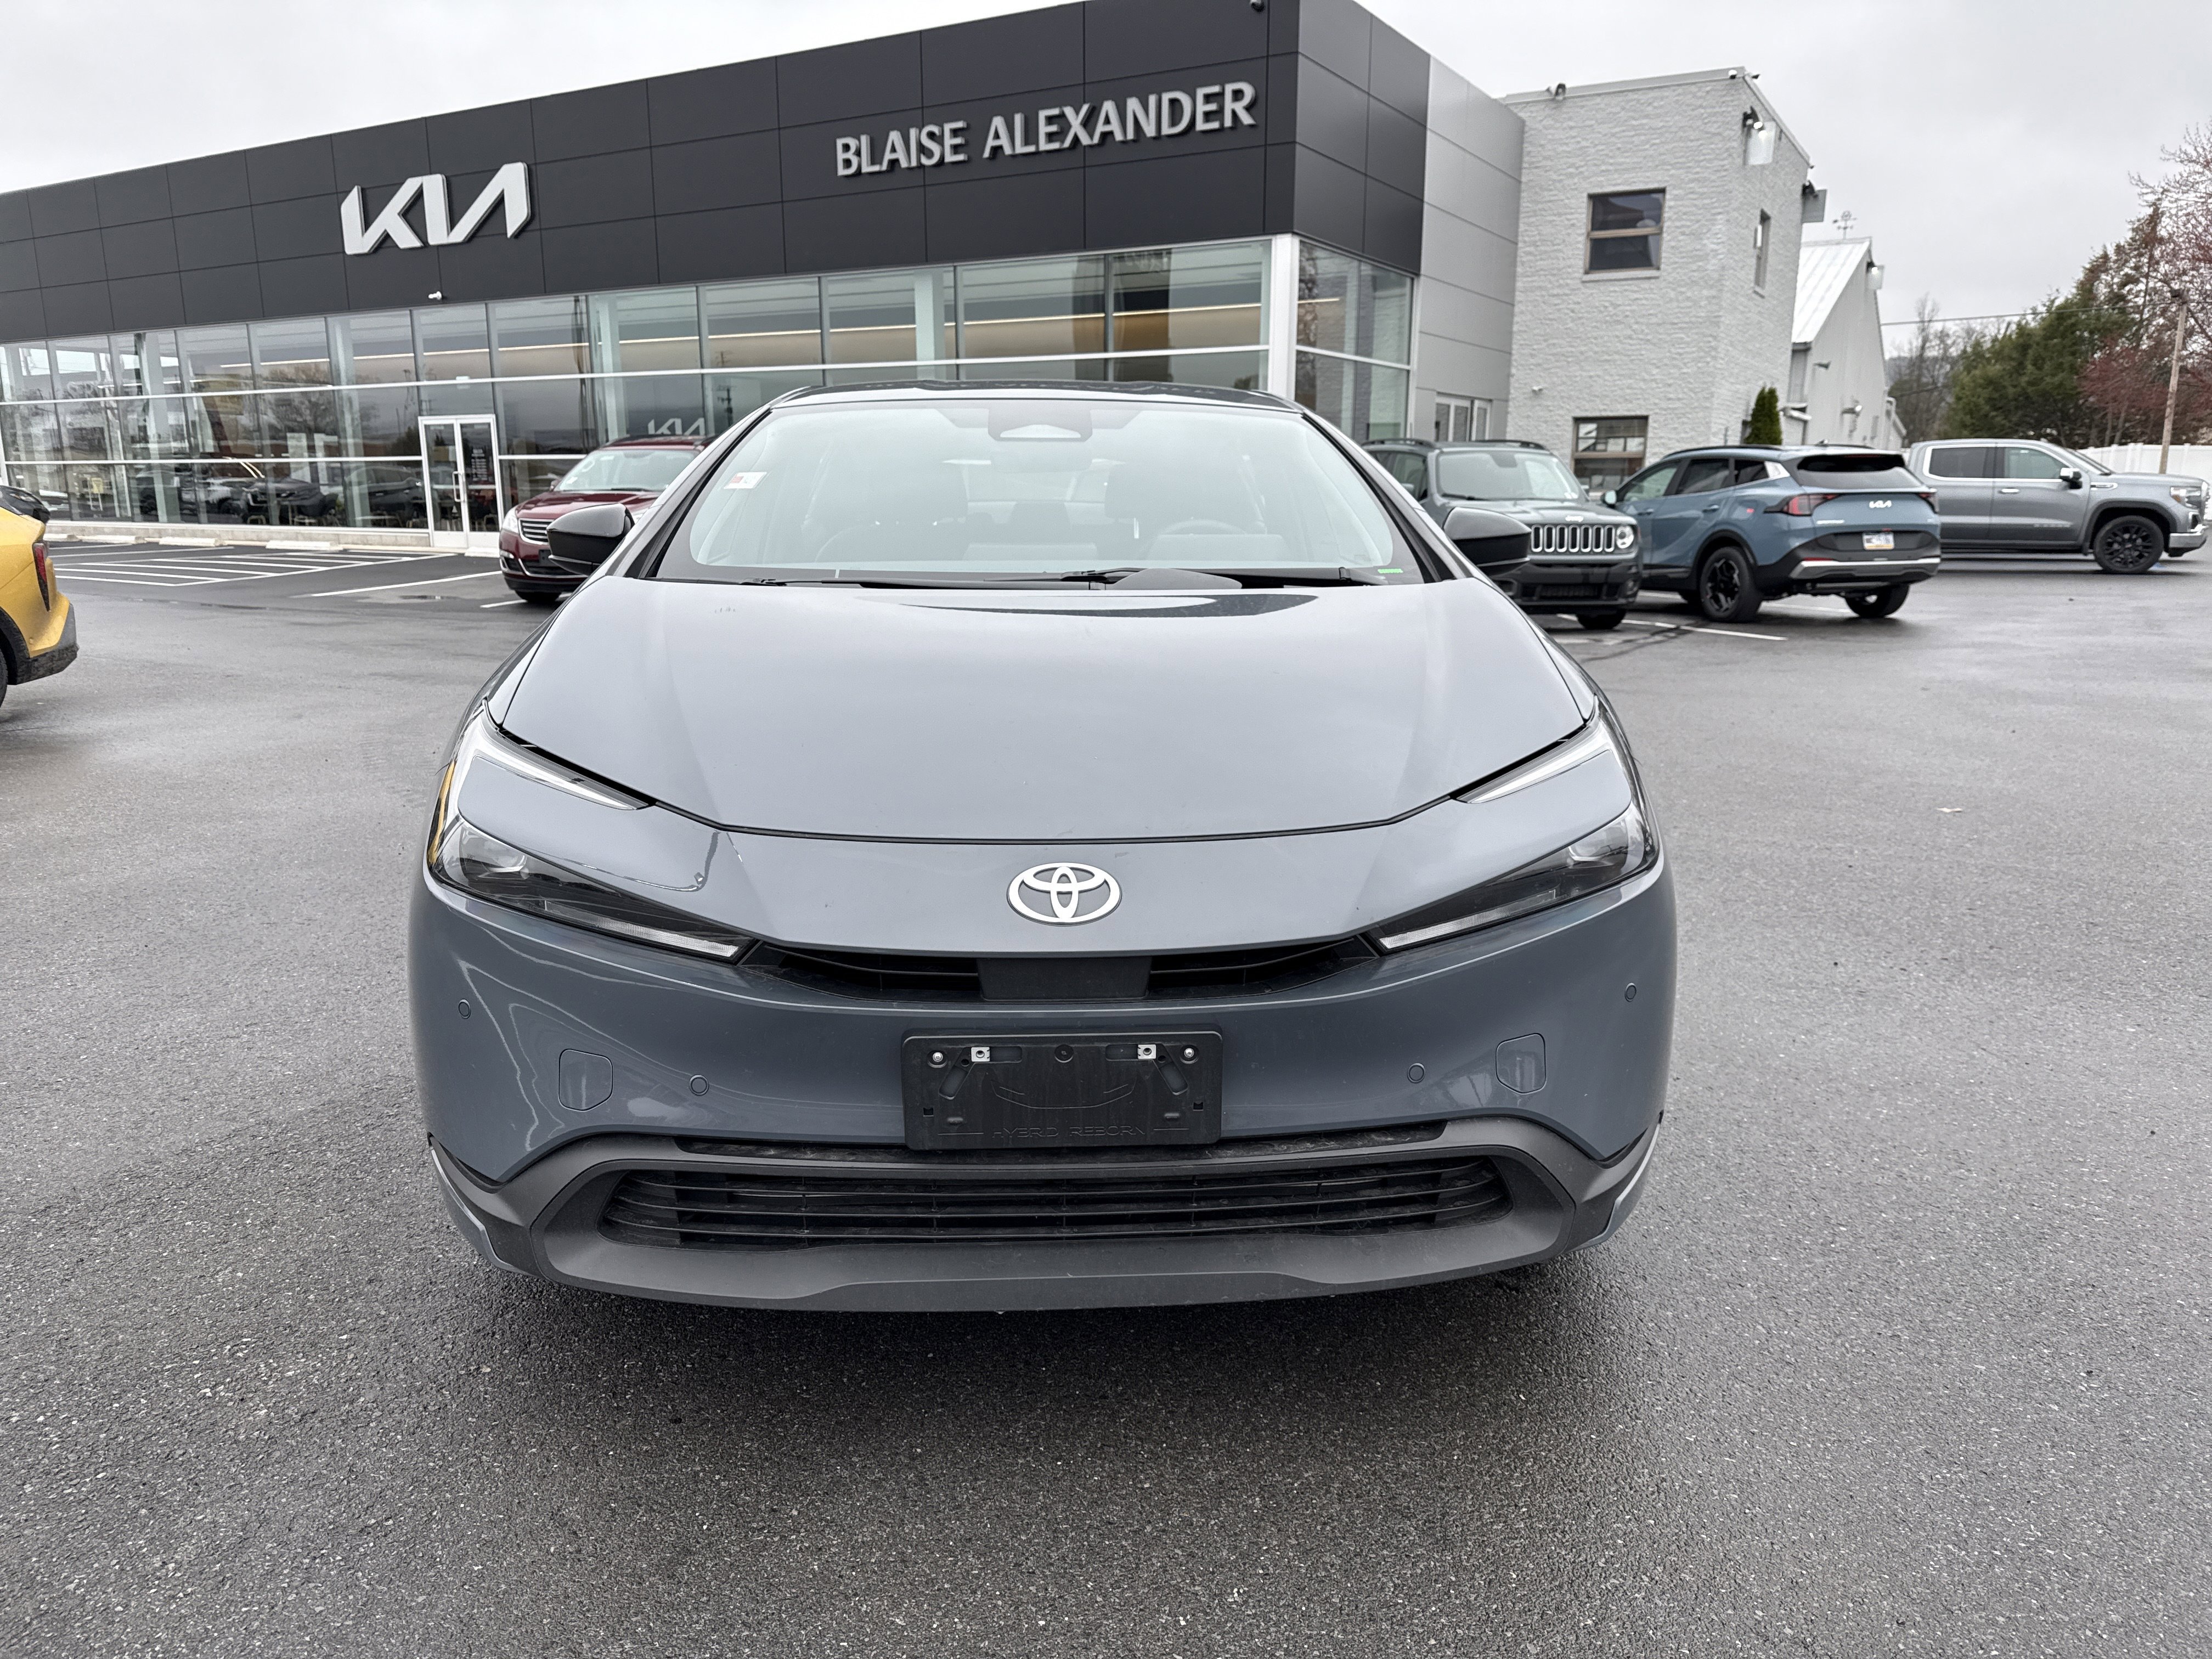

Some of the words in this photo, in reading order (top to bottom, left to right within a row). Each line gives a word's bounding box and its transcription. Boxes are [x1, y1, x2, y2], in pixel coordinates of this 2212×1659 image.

[836, 120, 968, 177] BLAISE
[983, 81, 1257, 158] ALEXANDER
[341, 162, 531, 256] KIA
[648, 417, 706, 436] KIA
